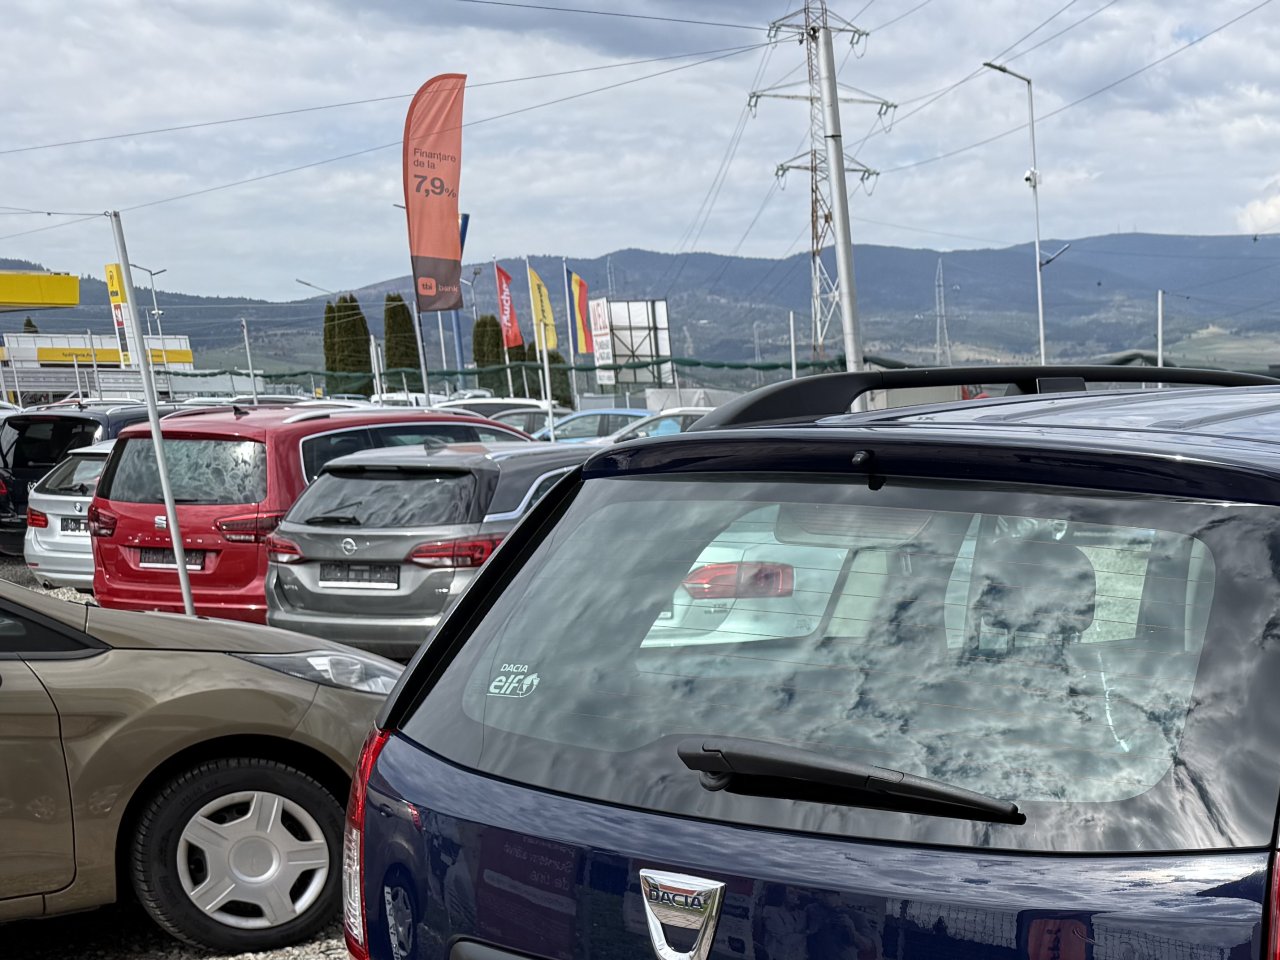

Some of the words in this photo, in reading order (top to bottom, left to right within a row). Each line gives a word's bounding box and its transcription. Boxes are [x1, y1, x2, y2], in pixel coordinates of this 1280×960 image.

[413, 173, 457, 198] 7,9%
[500, 663, 529, 673] DACIA
[489, 674, 525, 694] elf
[648, 888, 704, 910] DACIA
